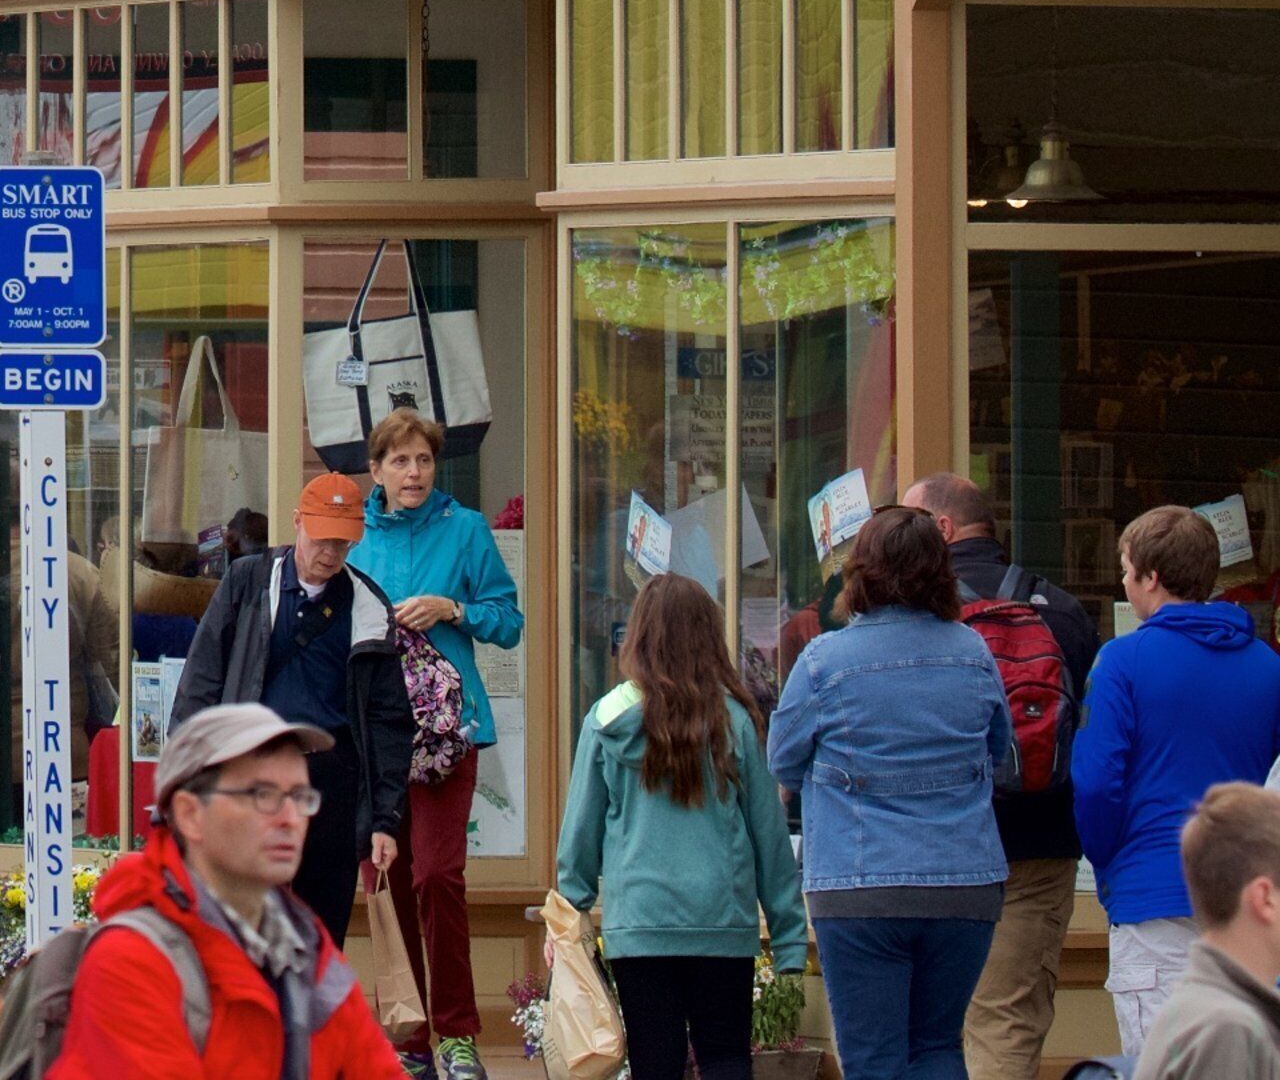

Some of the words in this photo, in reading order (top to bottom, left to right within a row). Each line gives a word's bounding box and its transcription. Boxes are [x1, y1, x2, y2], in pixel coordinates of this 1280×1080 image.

[2, 184, 93, 205] SMART
[2, 209, 26, 218] BUS
[30, 209, 60, 218] STOP
[64, 209, 93, 218] ONLY
[14, 307, 33, 316] MAY
[37, 307, 42, 316] 1
[53, 307, 76, 316] OCT.
[78, 307, 83, 316] 1
[8, 320, 42, 329] 7:00AM
[54, 320, 90, 329] 9:00PM
[4, 368, 93, 391] BEGIN
[386, 380, 418, 391] ALASKA
[41, 475, 59, 630] CITY
[43, 680, 64, 934] TRANSI
